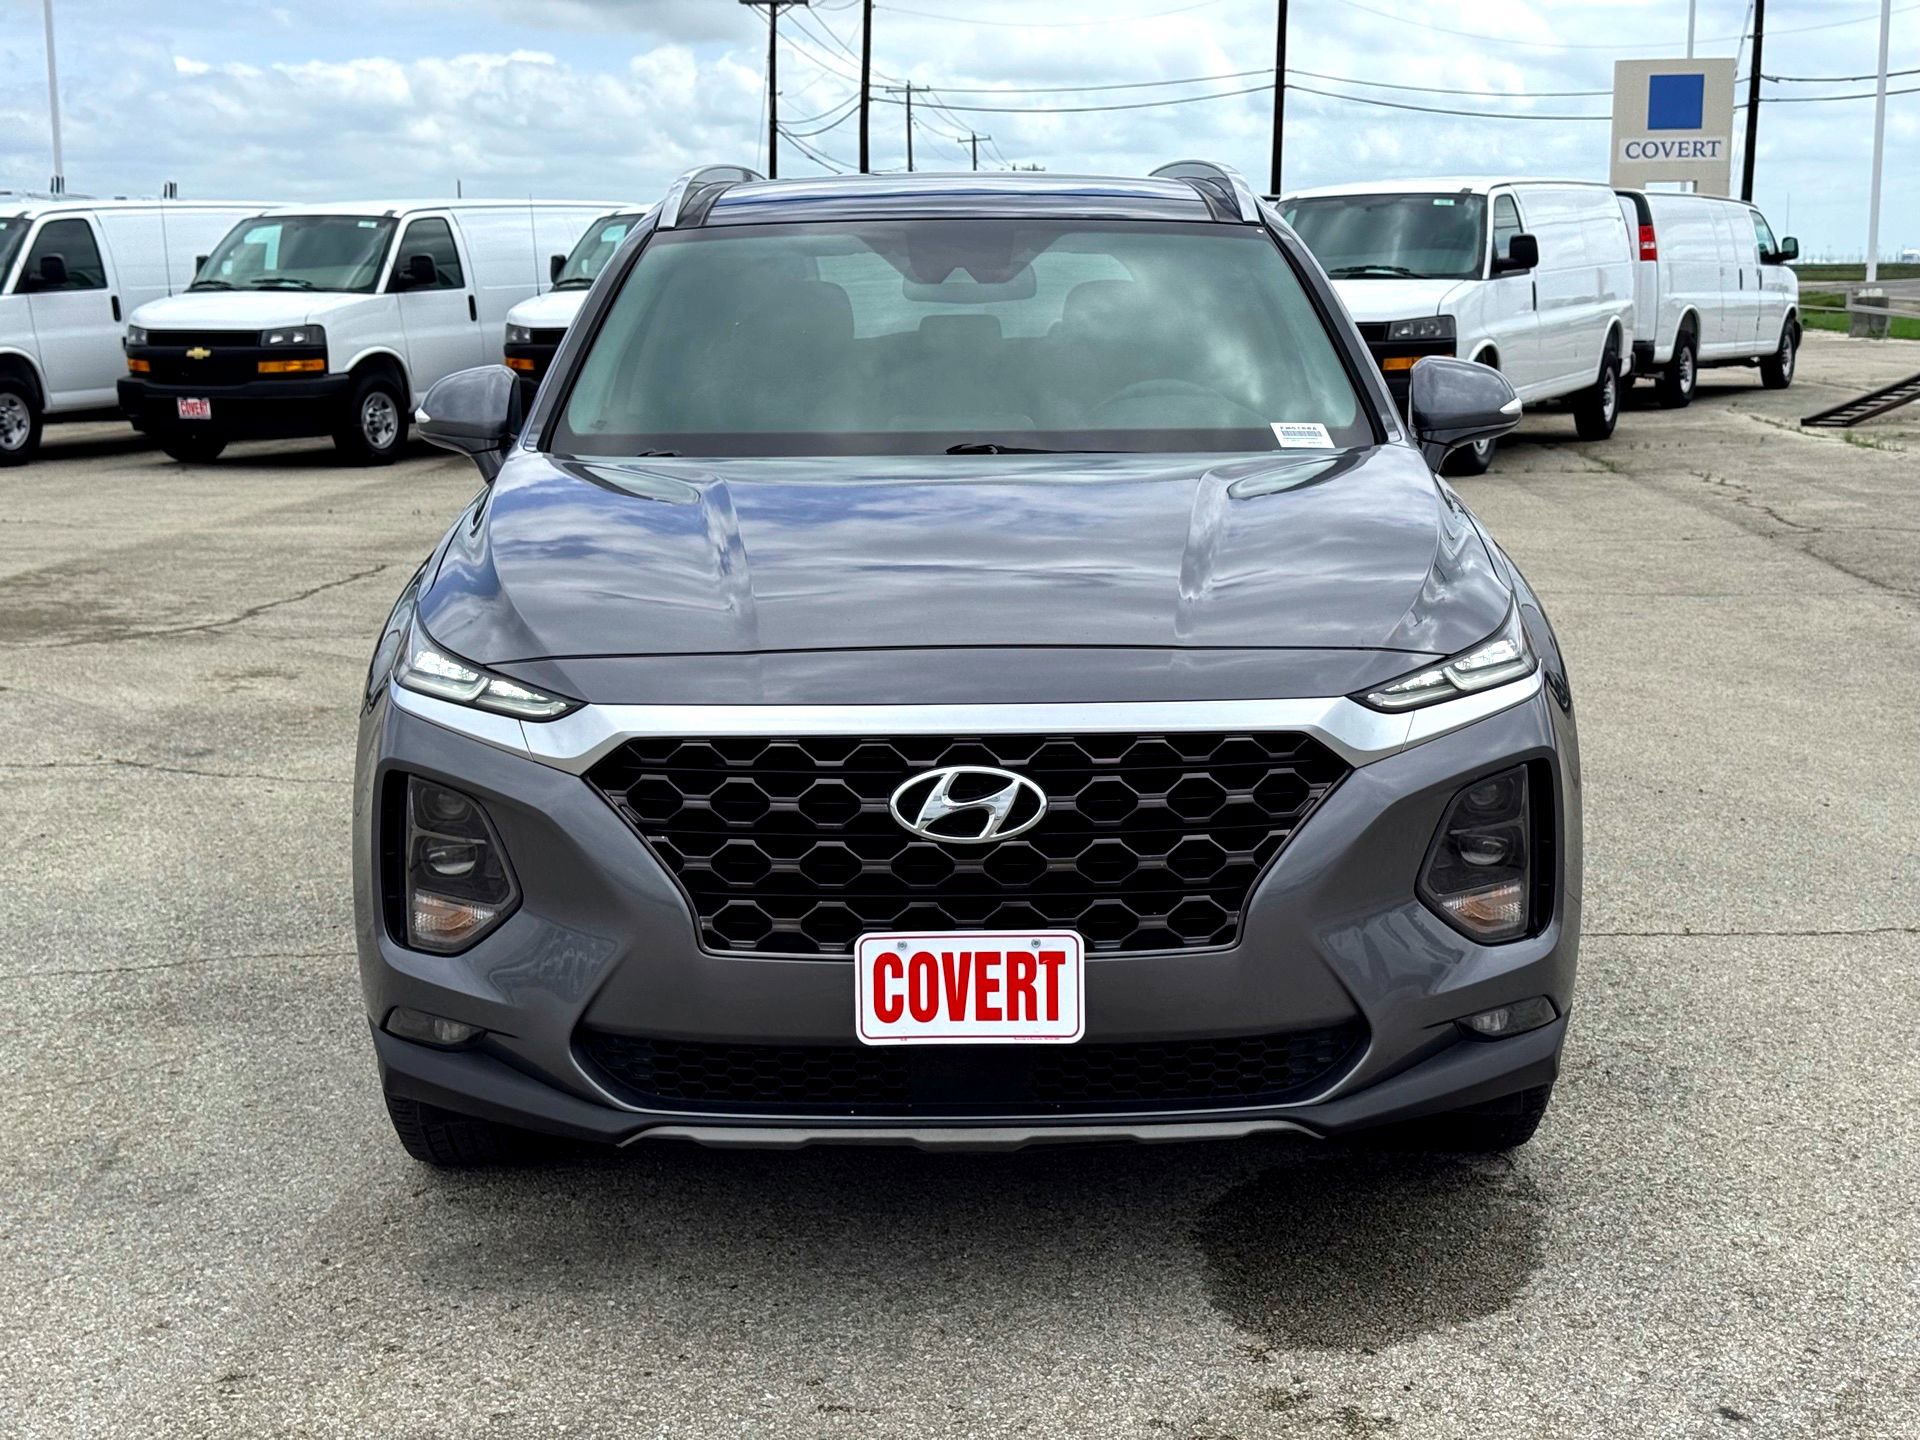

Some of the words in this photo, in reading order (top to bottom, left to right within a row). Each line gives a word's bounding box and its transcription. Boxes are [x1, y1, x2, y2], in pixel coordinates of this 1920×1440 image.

[1625, 140, 1721, 159] COVERT
[180, 400, 209, 416] COVERT
[873, 951, 1066, 1023] COVERT
